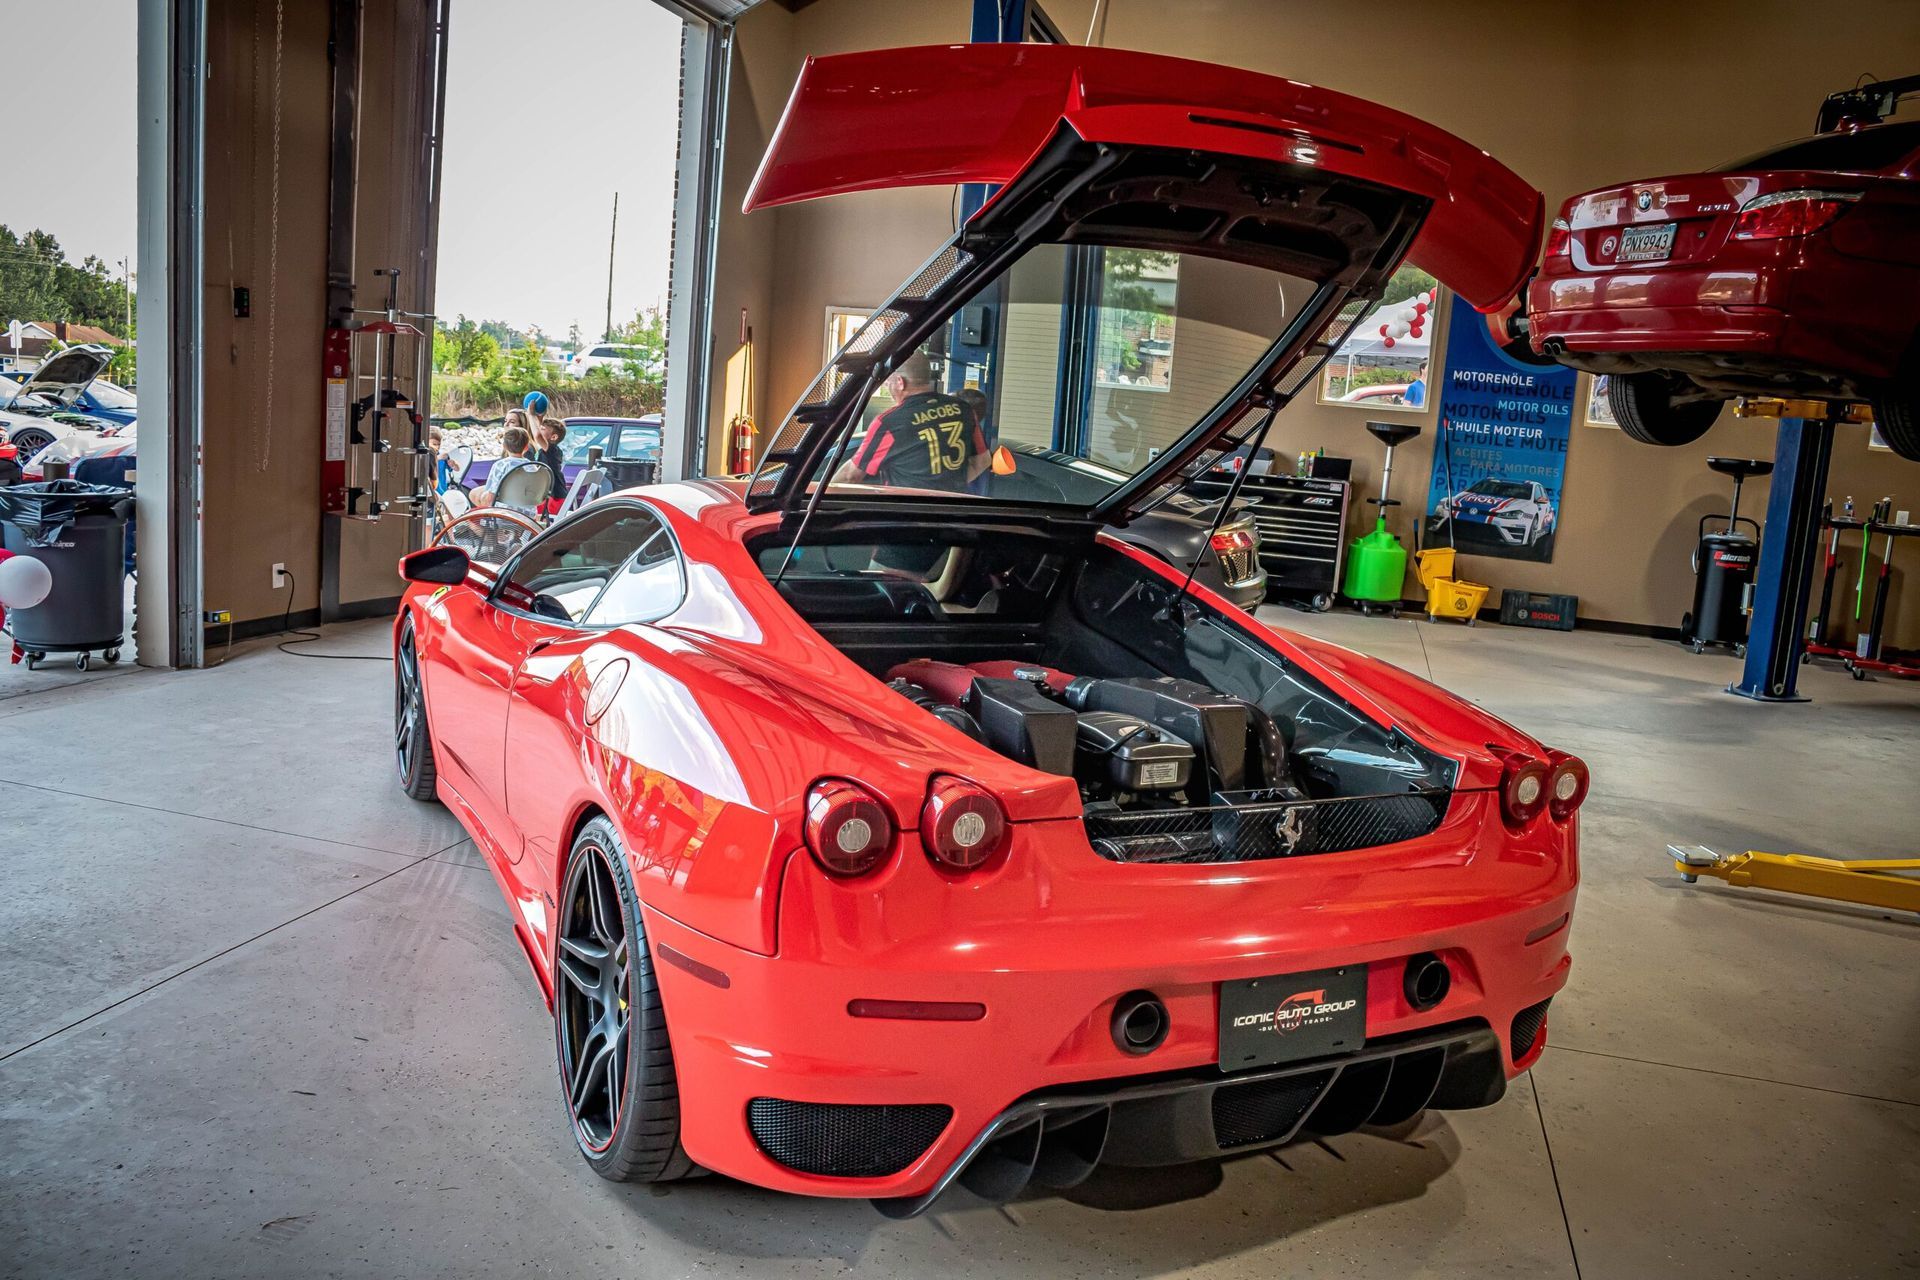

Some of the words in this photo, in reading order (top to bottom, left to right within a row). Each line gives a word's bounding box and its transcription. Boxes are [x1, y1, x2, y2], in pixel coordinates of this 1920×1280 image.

[1624, 233, 1669, 252] PNX9943
[1453, 370, 1534, 387] MOTORENÖLE
[911, 403, 962, 425] JACOBS
[1498, 400, 1539, 413] MOTOR
[1542, 404, 1569, 416] OILS
[1447, 420, 1491, 434] L'HUILE
[1493, 425, 1543, 439] MOTEUR
[917, 420, 966, 475] 13
[1454, 447, 1503, 461] ACEITES
[1470, 460, 1501, 473] PARA
[1504, 463, 1560, 478] MOTORES
[1530, 610, 1560, 622] BOSCH
[605, 839, 629, 902] MICHELIN
[1233, 1011, 1274, 1027] ICONIC
[1277, 1006, 1312, 1020] AUTO
[1313, 999, 1357, 1014] GROUP
[1281, 1021, 1300, 1029] SELL
